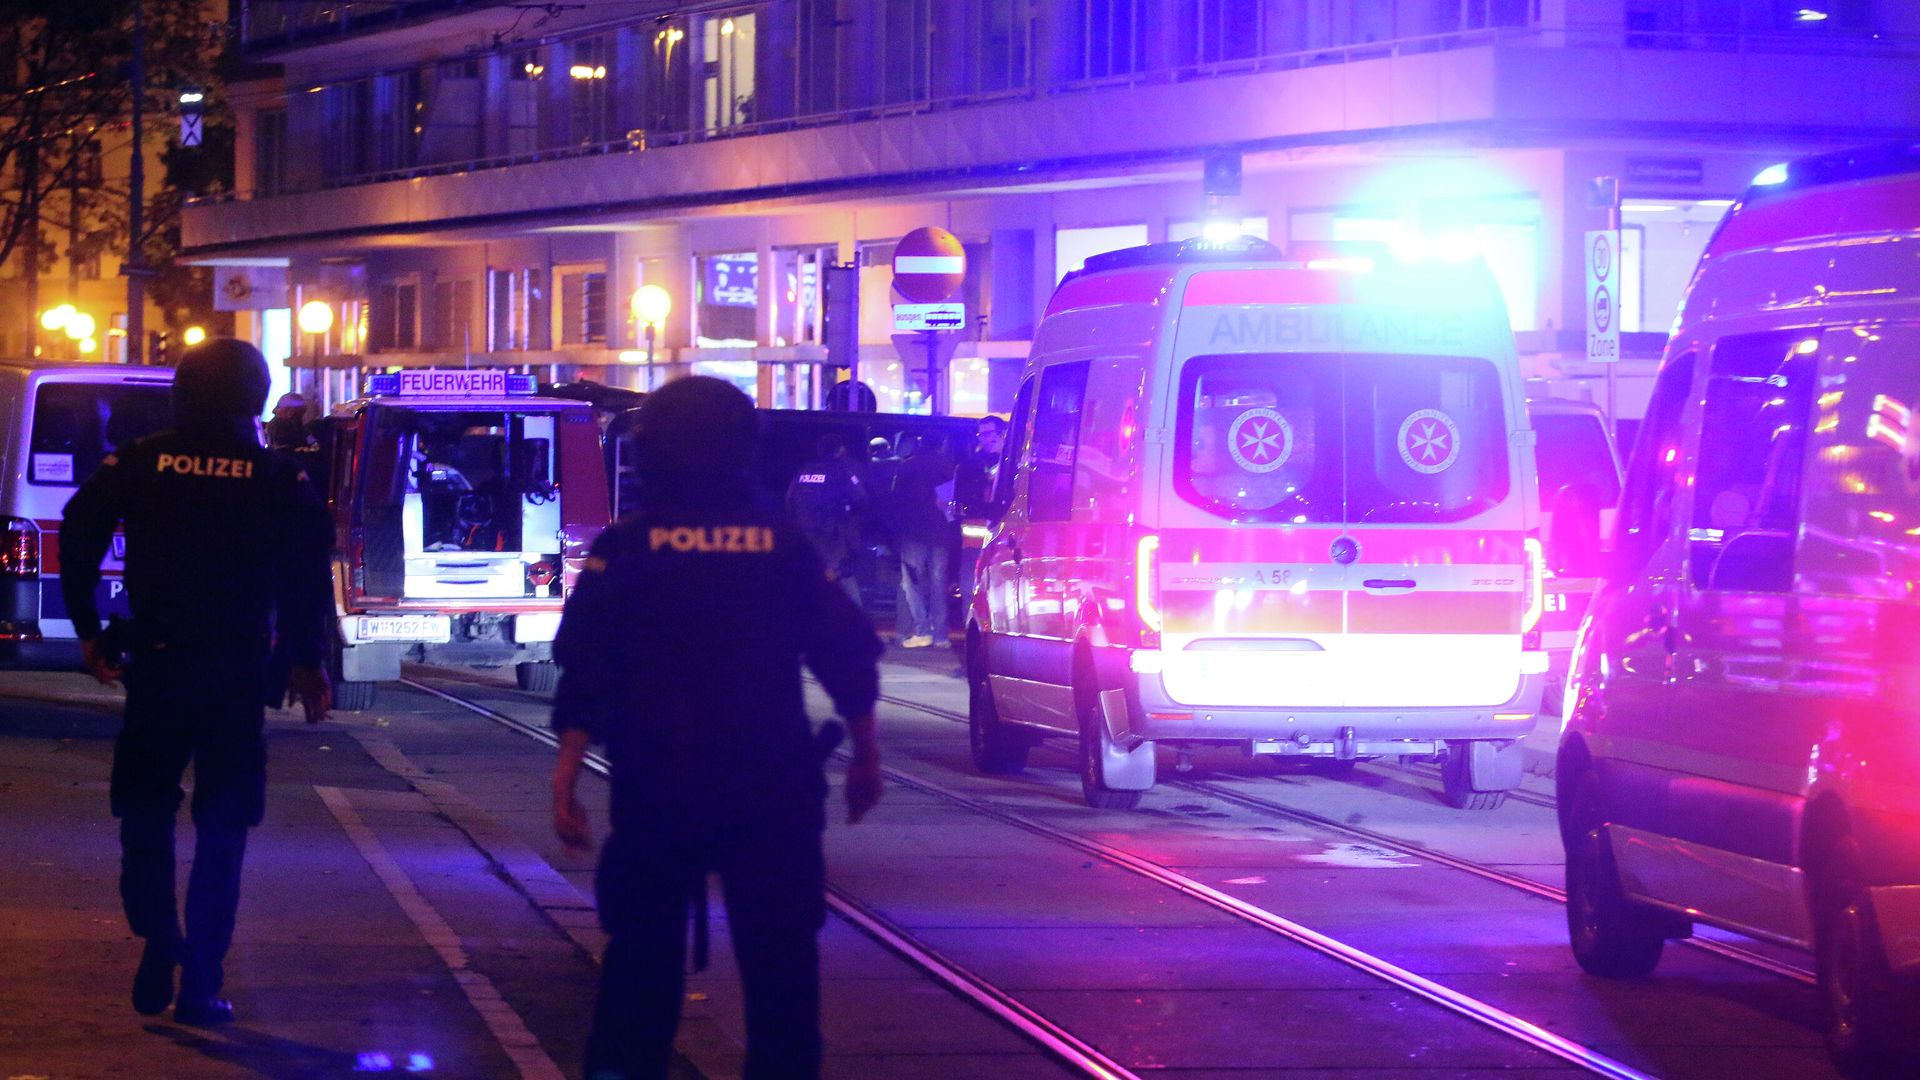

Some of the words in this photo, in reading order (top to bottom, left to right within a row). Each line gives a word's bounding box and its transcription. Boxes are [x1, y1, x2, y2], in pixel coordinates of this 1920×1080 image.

[1208, 312, 1464, 346] AMBULANCE
[1591, 333, 1615, 357] Zone
[402, 374, 503, 391] FEUERWEHR
[157, 453, 254, 478] POLIZEI
[649, 526, 774, 552] POLIZEI
[1254, 569, 1266, 585] A
